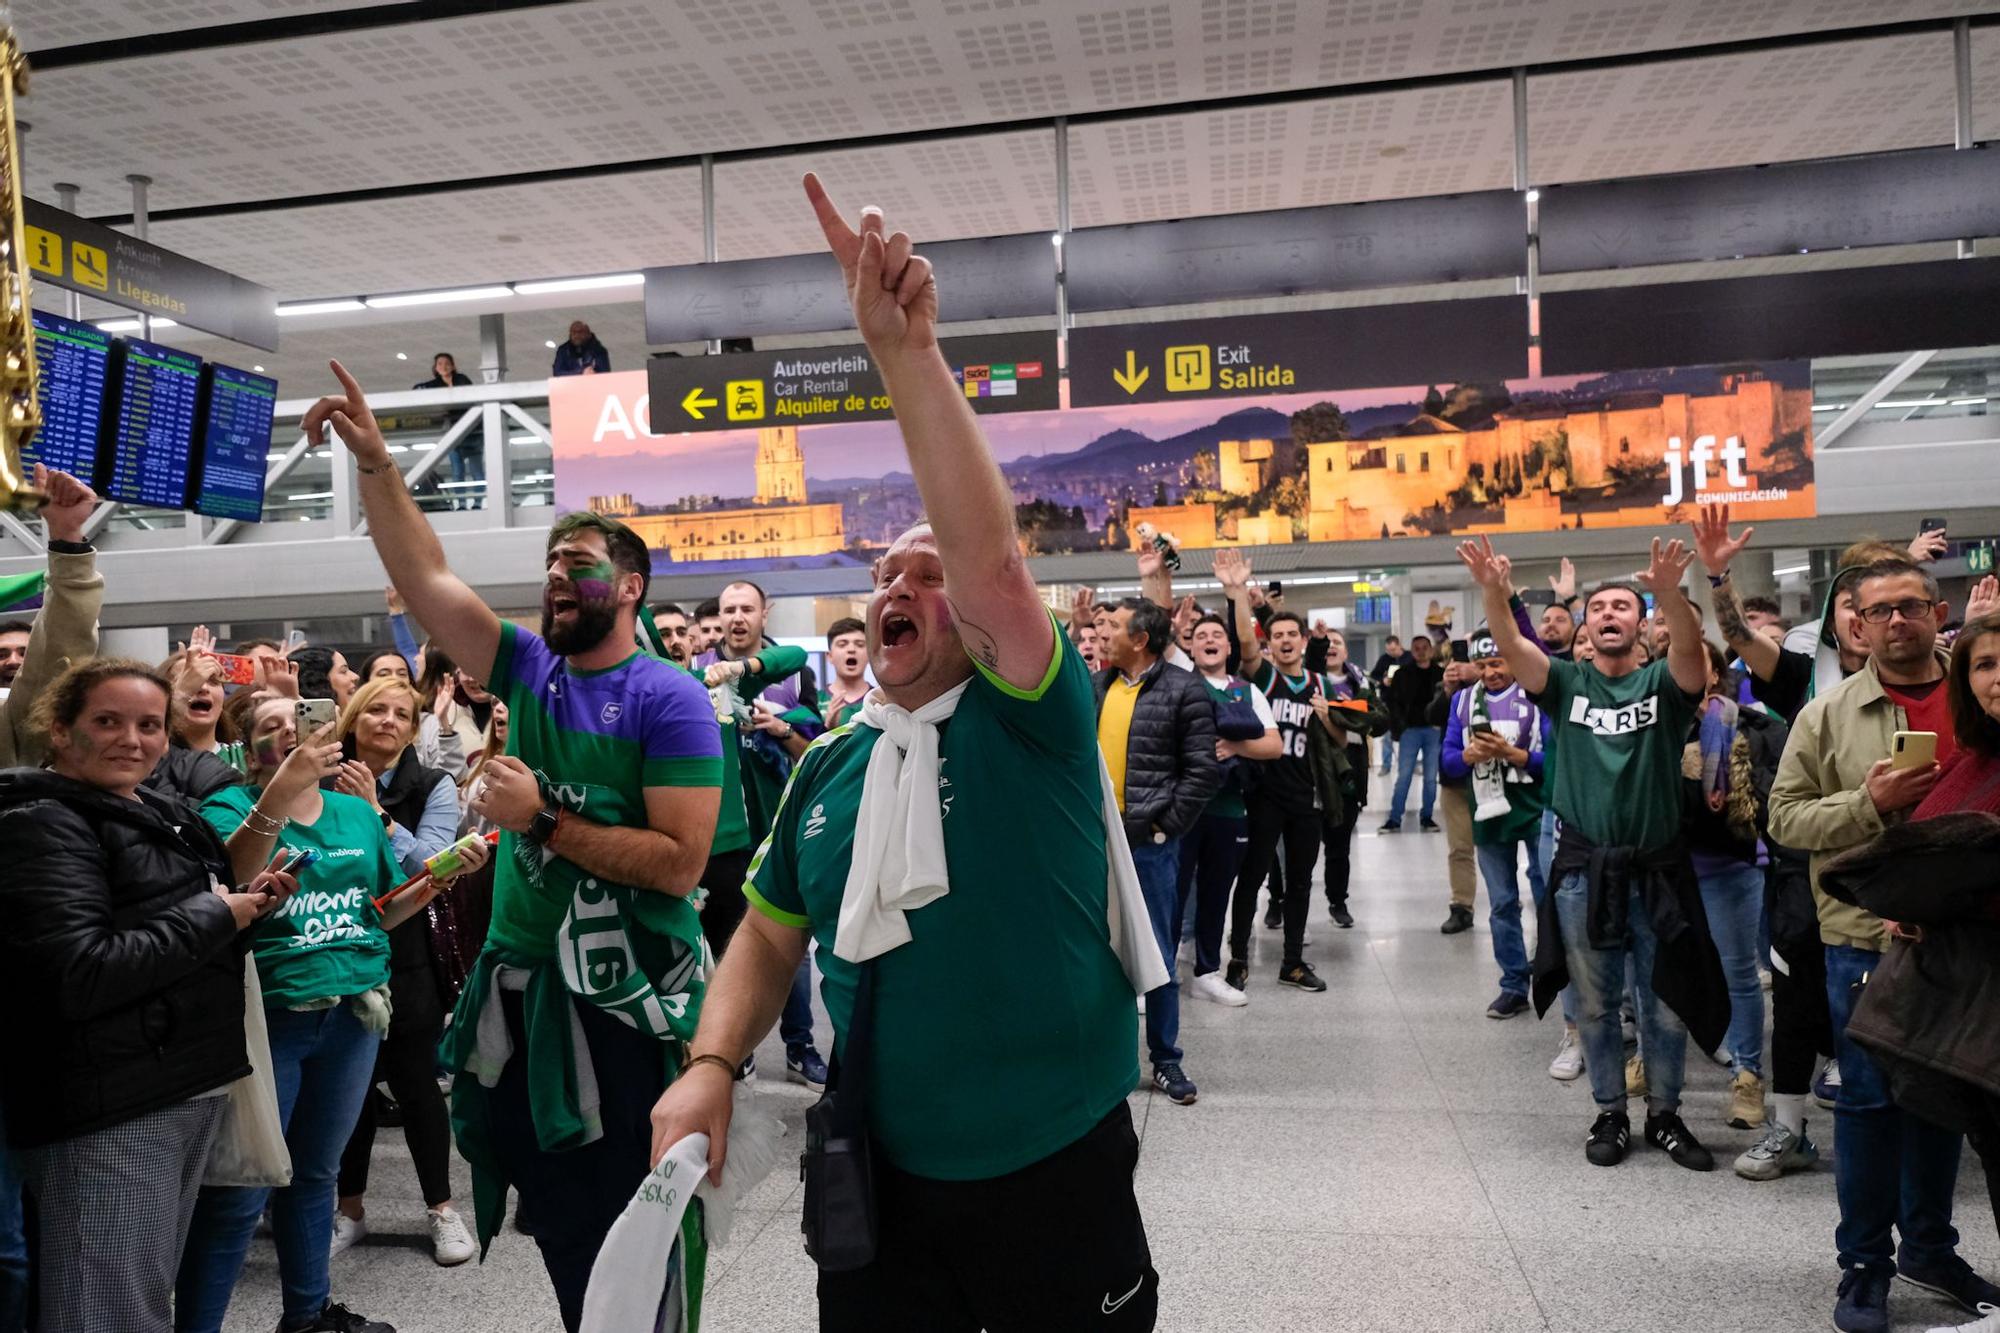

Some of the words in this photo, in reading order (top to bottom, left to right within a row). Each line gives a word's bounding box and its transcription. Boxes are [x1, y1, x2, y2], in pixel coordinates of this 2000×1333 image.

[117, 278, 187, 315] Llegadas
[69, 328, 105, 343] LLEGADAS
[1217, 345, 1251, 365] Exit
[773, 356, 868, 378] Autoverleih
[1219, 365, 1295, 390] Salida
[774, 382, 798, 396] Car
[803, 378, 849, 395] Rental
[775, 396, 840, 418] Alquiler
[844, 394, 865, 412] de
[870, 396, 891, 410] co
[1663, 435, 1747, 506] jft
[1695, 487, 1788, 505] COMUNICACIÓN
[1283, 729, 1307, 758] 16
